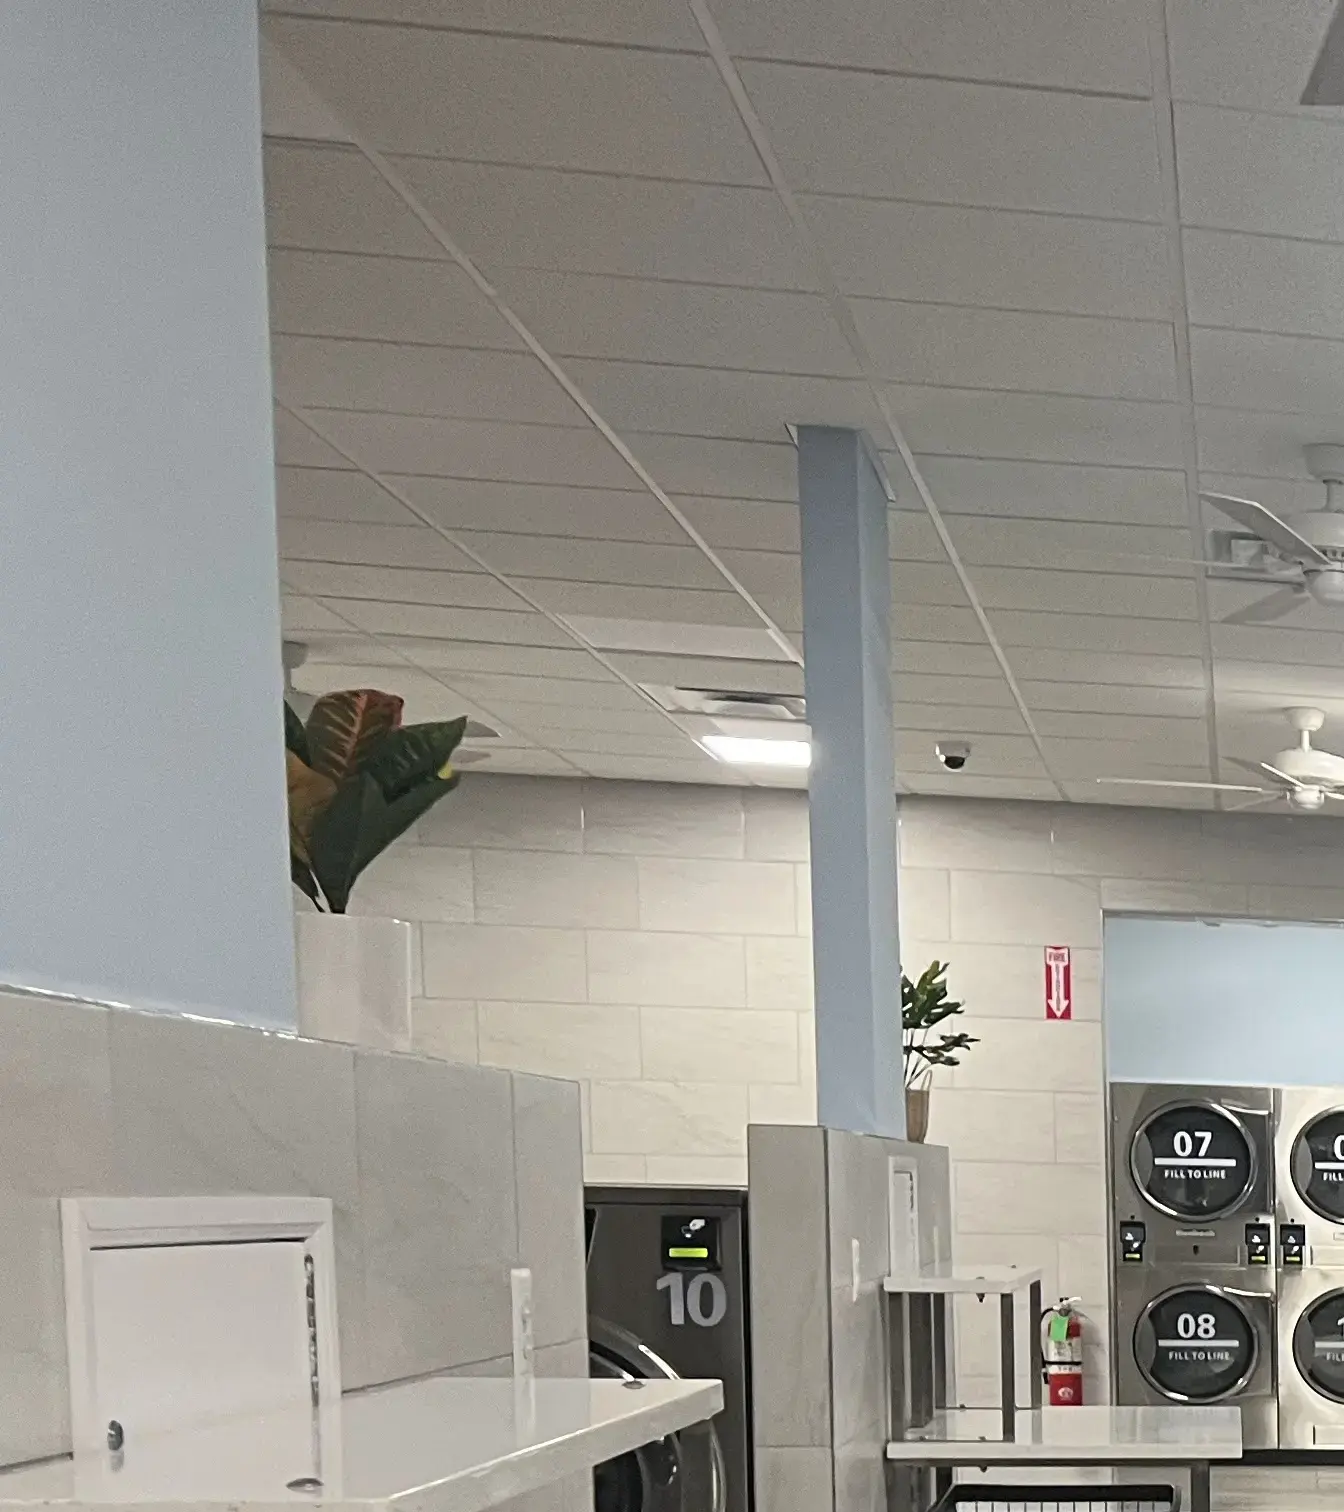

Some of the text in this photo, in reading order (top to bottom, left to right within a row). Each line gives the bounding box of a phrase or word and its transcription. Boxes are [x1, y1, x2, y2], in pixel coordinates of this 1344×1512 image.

[1173, 1130, 1213, 1157] 07
[1164, 1169, 1226, 1180] FILL TO LINE
[1323, 1172, 1344, 1182] FILL
[656, 1271, 727, 1327] 10
[1177, 1313, 1216, 1339] 08
[1168, 1351, 1230, 1361] FILL TO LINE
